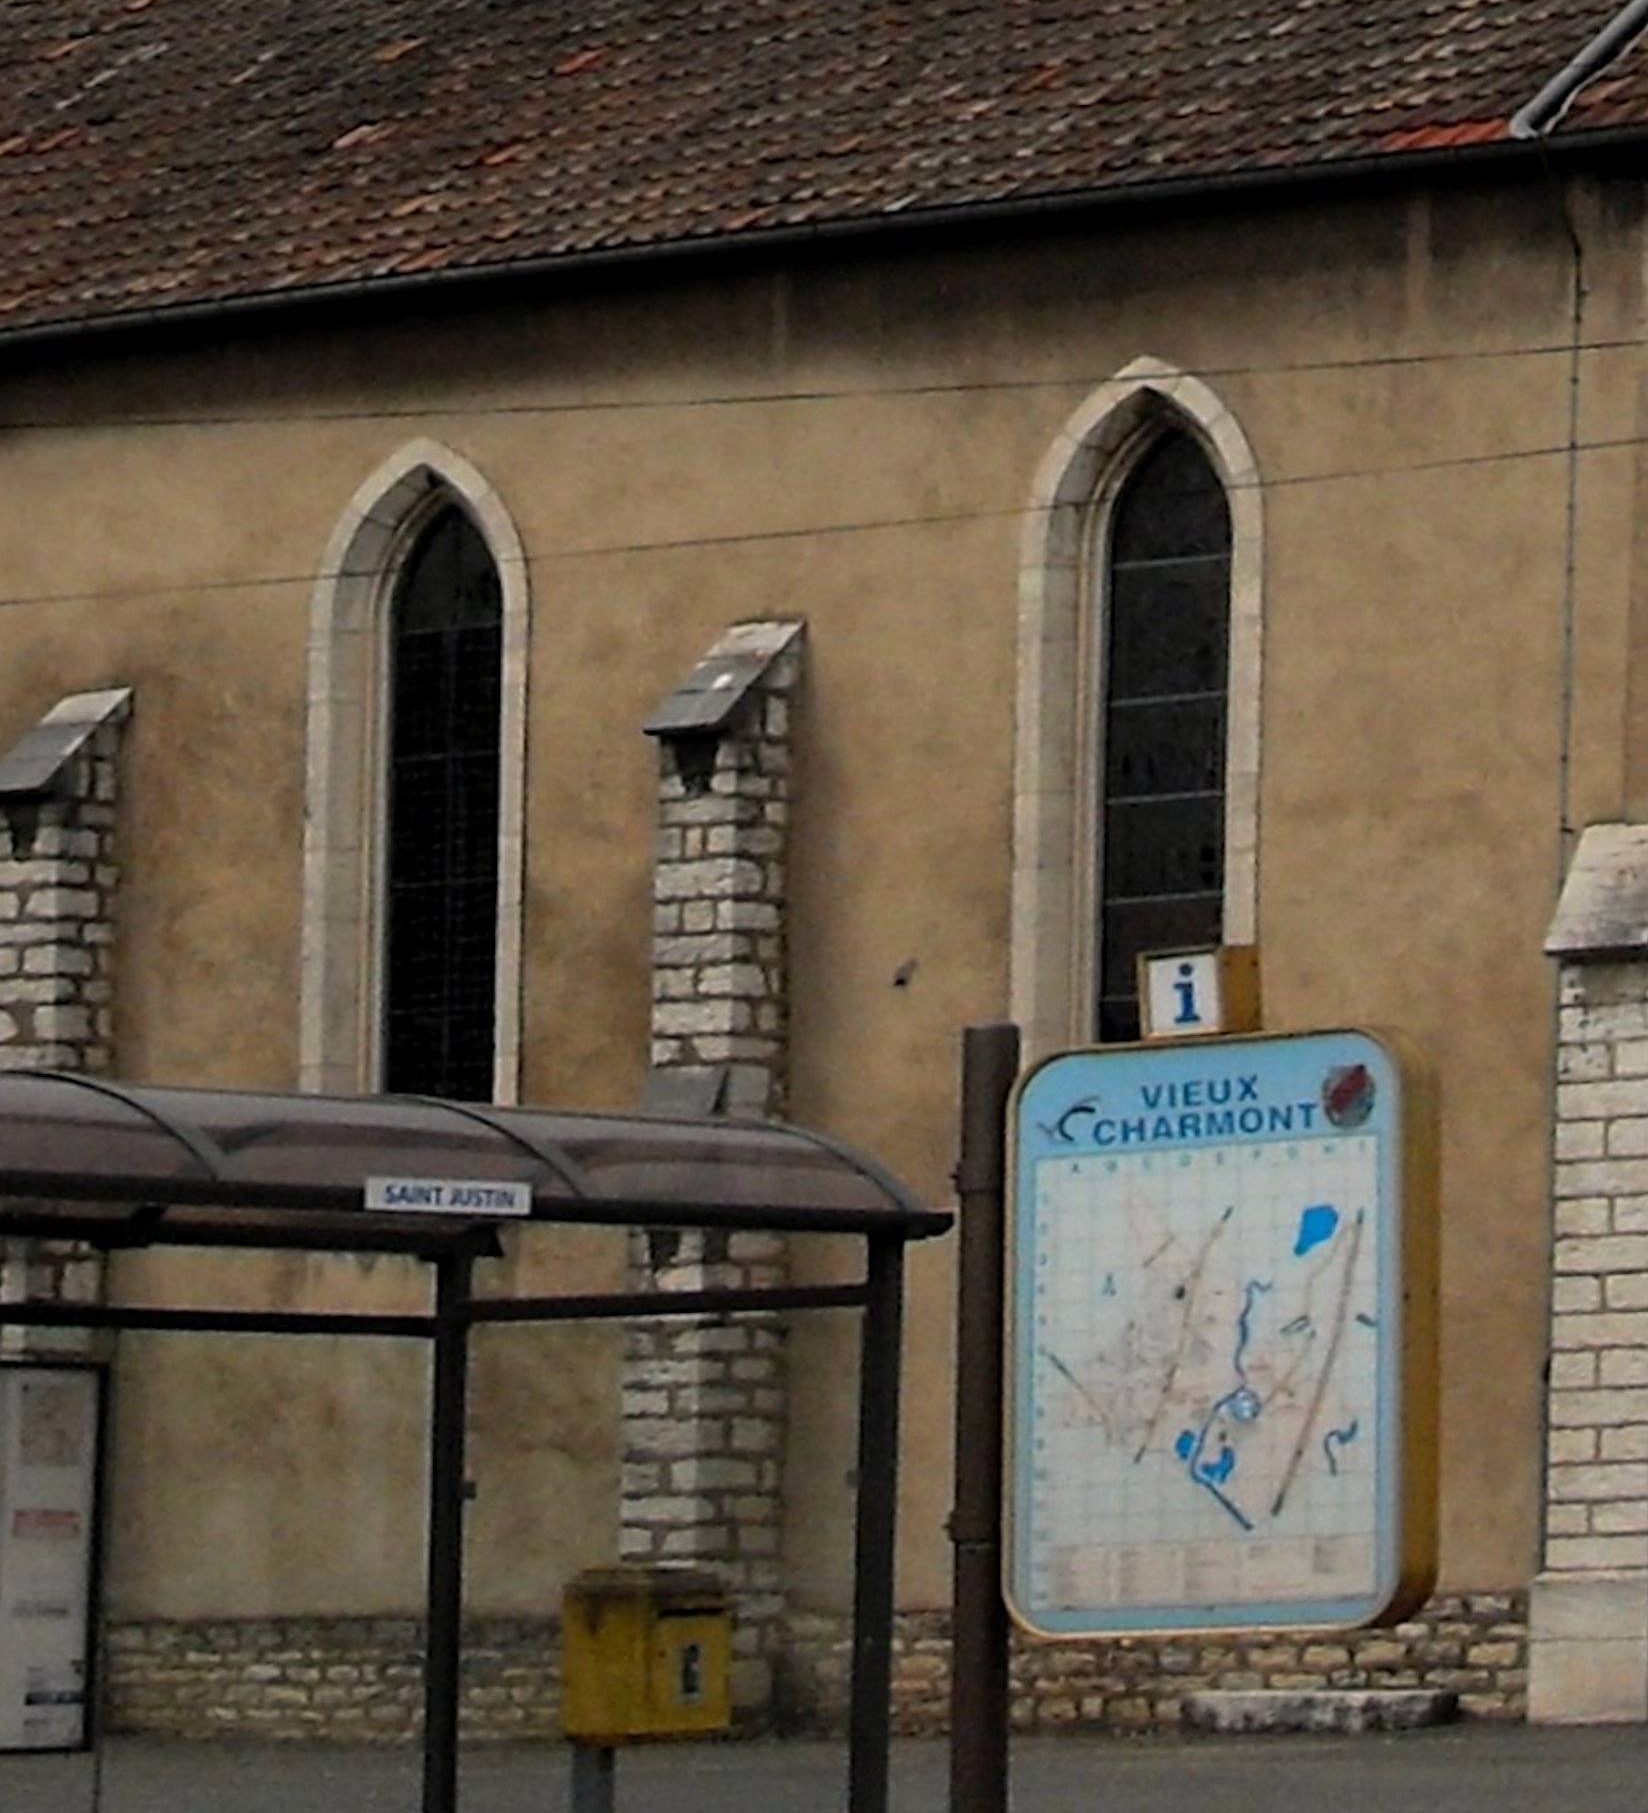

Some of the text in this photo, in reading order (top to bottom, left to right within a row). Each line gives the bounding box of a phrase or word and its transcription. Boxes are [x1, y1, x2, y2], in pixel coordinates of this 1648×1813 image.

[1140, 1074, 1260, 1110] VIEUX
[1092, 1102, 1319, 1146] CHARMONT
[384, 1184, 516, 1209] SAINT JUSTIN
